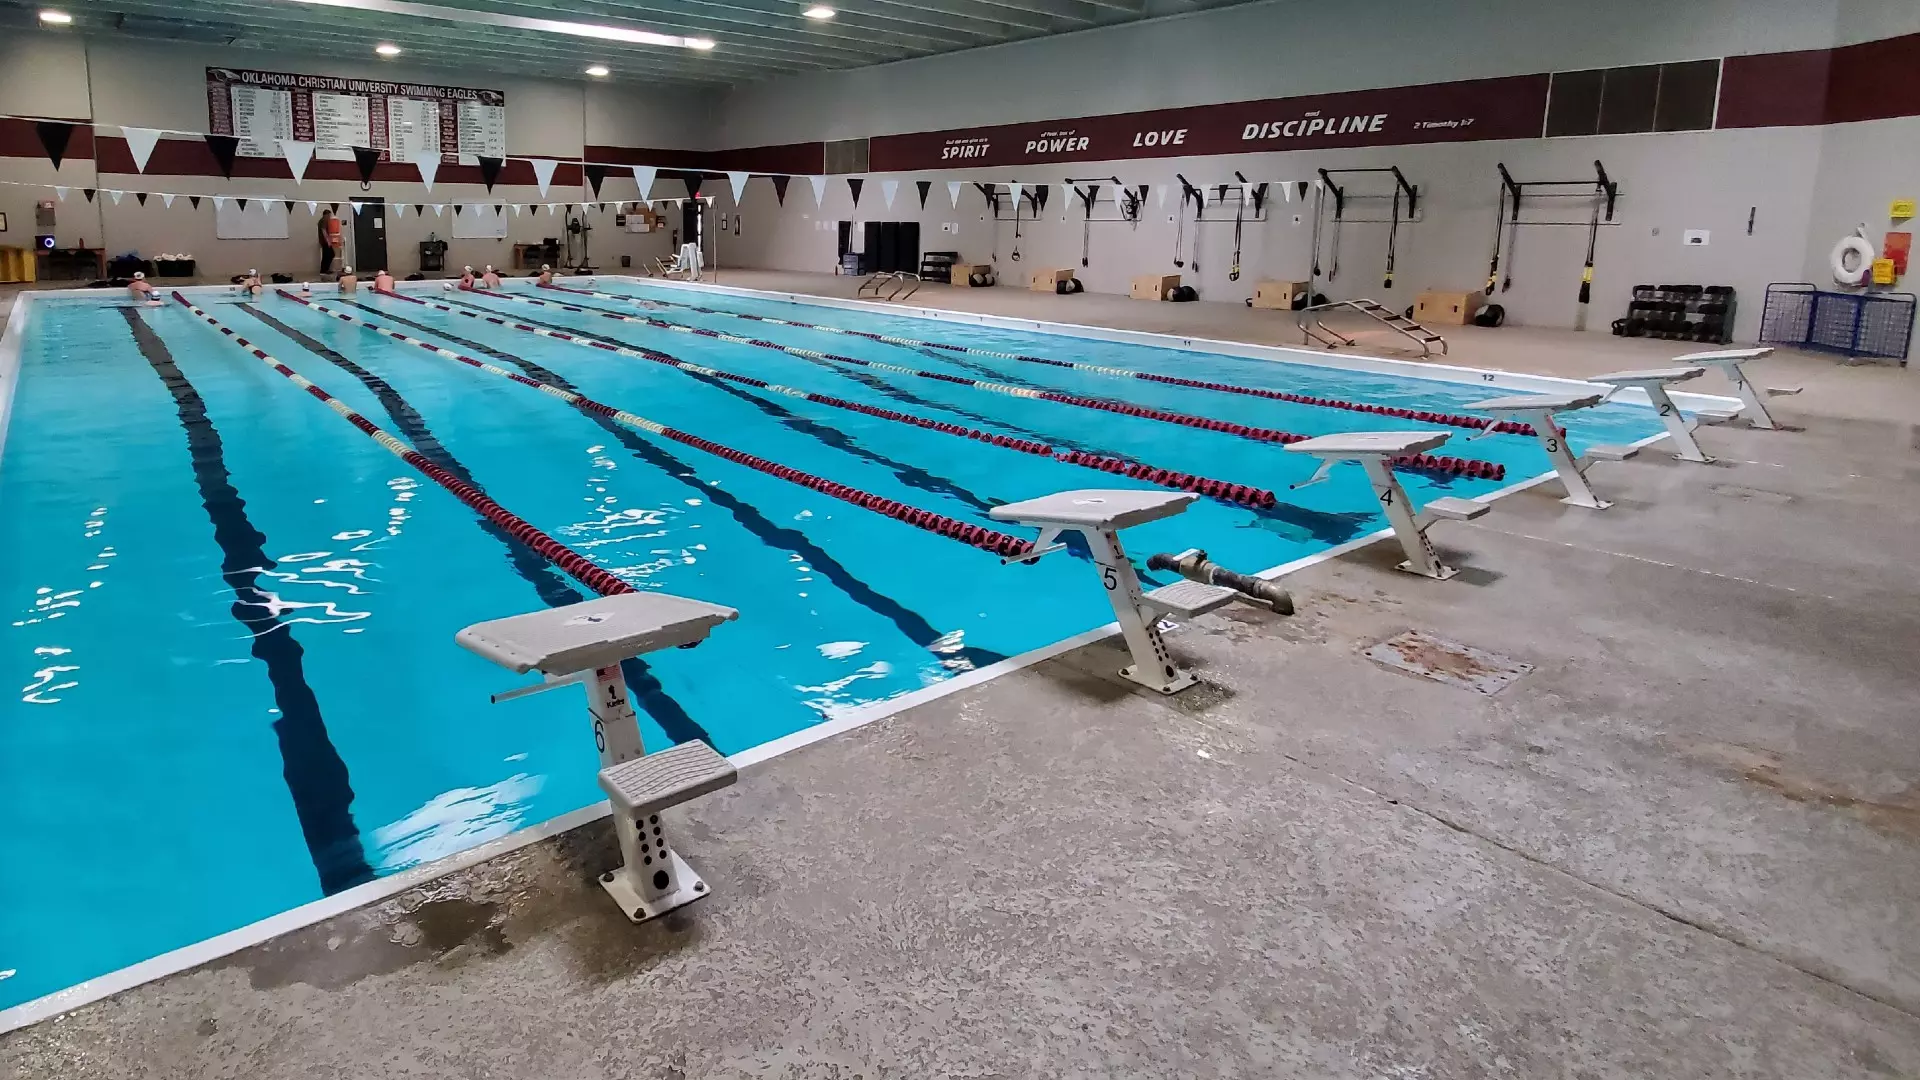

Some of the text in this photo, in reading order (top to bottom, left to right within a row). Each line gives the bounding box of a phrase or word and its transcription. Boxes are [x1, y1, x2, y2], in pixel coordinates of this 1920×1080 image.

[241, 71, 478, 100] OKLAHOMA CHRISTIAN UNIVERSITY SWIMMING EAGLES
[1241, 113, 1389, 140] DISCIPLINE
[1422, 120, 1459, 129] Timothy
[1025, 137, 1090, 154] POWER
[1132, 128, 1189, 147] LOVE
[941, 144, 991, 160] SPIRIT
[1481, 374, 1495, 382] 12
[1736, 379, 1743, 391] 1
[1659, 404, 1671, 417] 2
[1546, 438, 1558, 453] 3
[1379, 488, 1394, 507] 4
[1103, 567, 1118, 591] 5
[594, 719, 605, 754] 6
